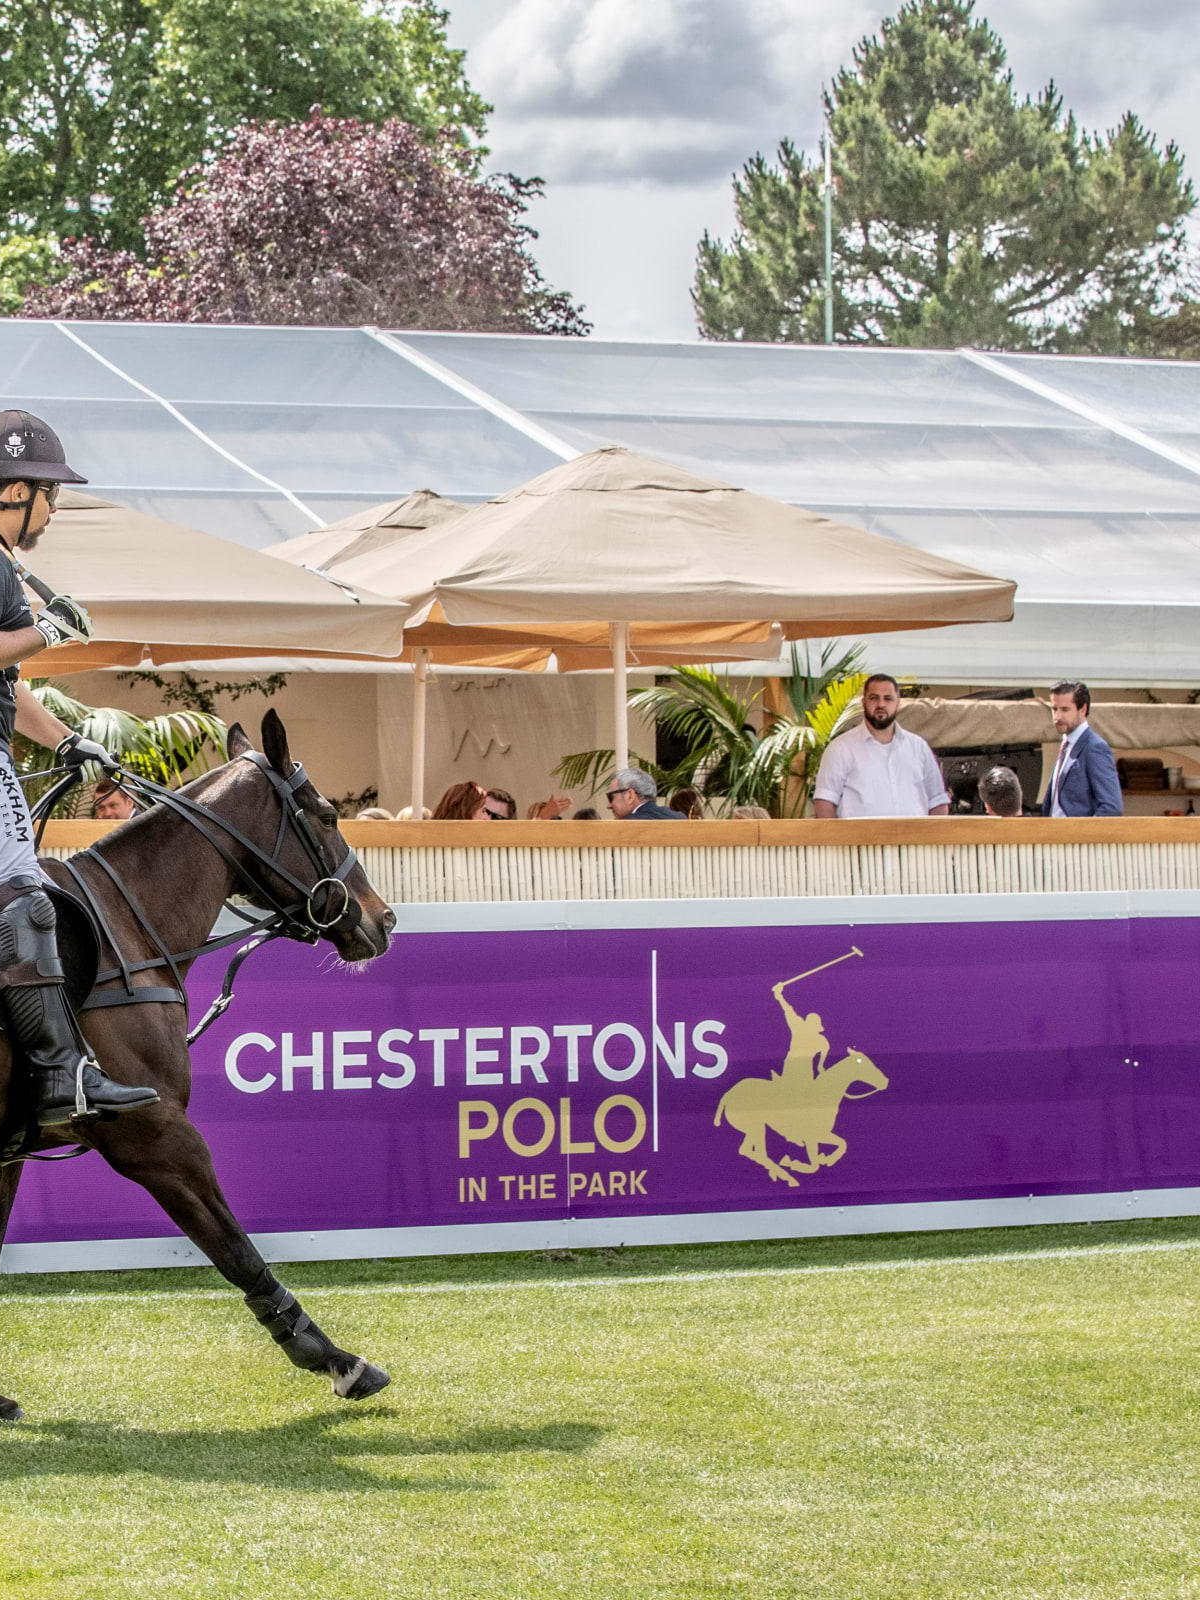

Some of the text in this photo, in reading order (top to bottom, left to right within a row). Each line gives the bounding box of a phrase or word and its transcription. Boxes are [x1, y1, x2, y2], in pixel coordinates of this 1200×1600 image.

[0, 803, 13, 838] TEAM
[225, 1020, 729, 1094] CHESTERTONS
[458, 1094, 647, 1159] POLO
[458, 1169, 649, 1203] IN THE PARK
